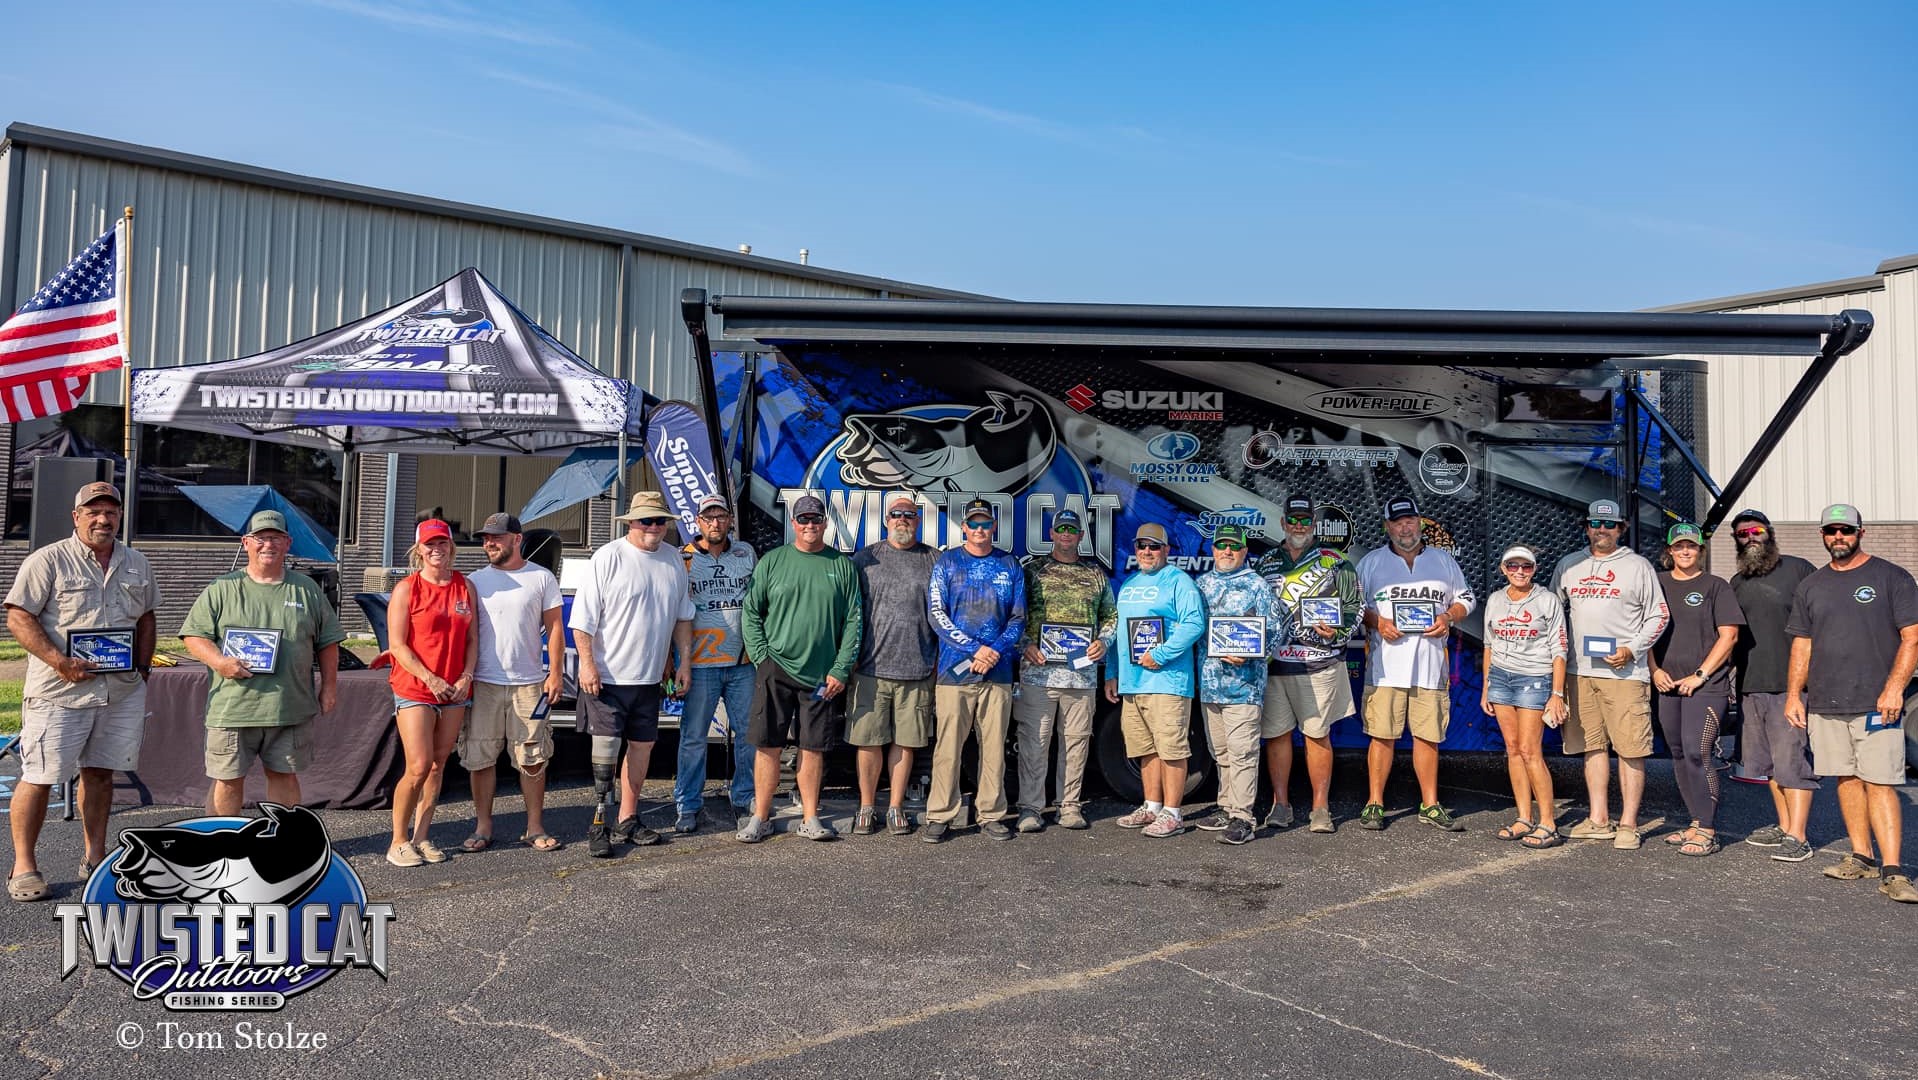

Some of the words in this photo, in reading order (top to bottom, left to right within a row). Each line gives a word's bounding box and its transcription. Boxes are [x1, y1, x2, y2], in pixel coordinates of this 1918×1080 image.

[355, 325, 460, 344] TWISTED
[456, 327, 505, 345] CAT
[198, 384, 559, 416] TWISTEDCATOUTDOORS.COM
[1101, 389, 1224, 411] SUZUKI
[1320, 396, 1435, 411] POWER-POLE
[1168, 411, 1223, 421] MARINE
[1267, 447, 1399, 461] MARINEMASTER
[667, 437, 705, 505] Smoo
[1129, 462, 1185, 475] MOSSY
[1185, 463, 1218, 475] OAK
[1137, 475, 1211, 483] FISHING
[660, 464, 700, 536] Moves
[1198, 510, 1266, 526] Smooth
[1025, 493, 1121, 570] CAT
[691, 579, 726, 595] RIPPIN
[1119, 585, 1160, 602] PFG
[1570, 587, 1622, 597] POWER
[708, 598, 744, 610] SEAAR
[1494, 629, 1538, 637] POWER
